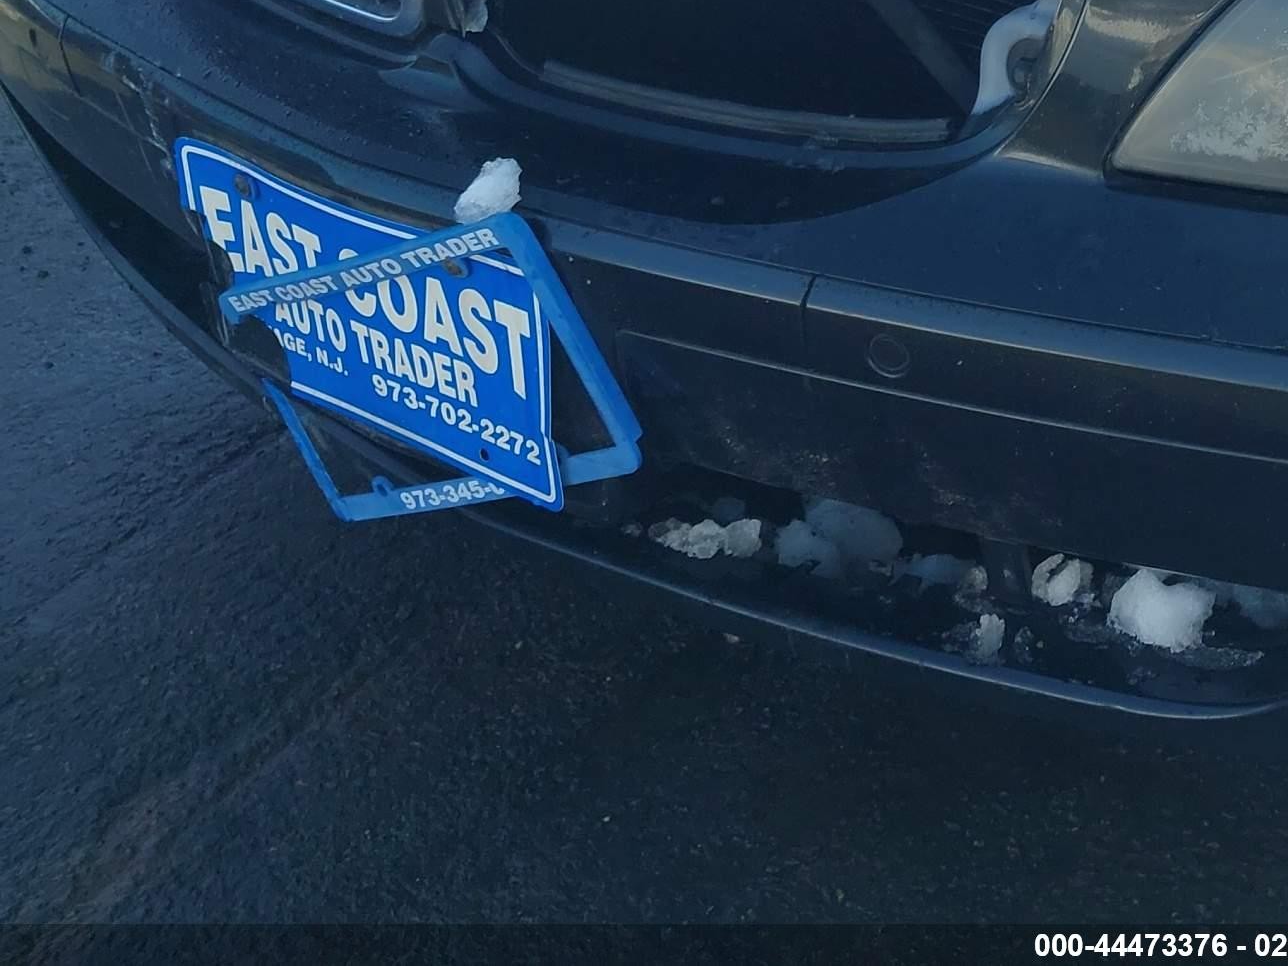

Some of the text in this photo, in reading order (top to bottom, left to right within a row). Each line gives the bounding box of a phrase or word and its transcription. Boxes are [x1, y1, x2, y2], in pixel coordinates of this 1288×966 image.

[200, 186, 322, 277] EAST
[228, 228, 499, 312] EAST COAST AUTO TRADER
[275, 298, 478, 408] AUTO TRADER
[316, 346, 349, 376] N.J.
[372, 374, 542, 465] 973-702-2272
